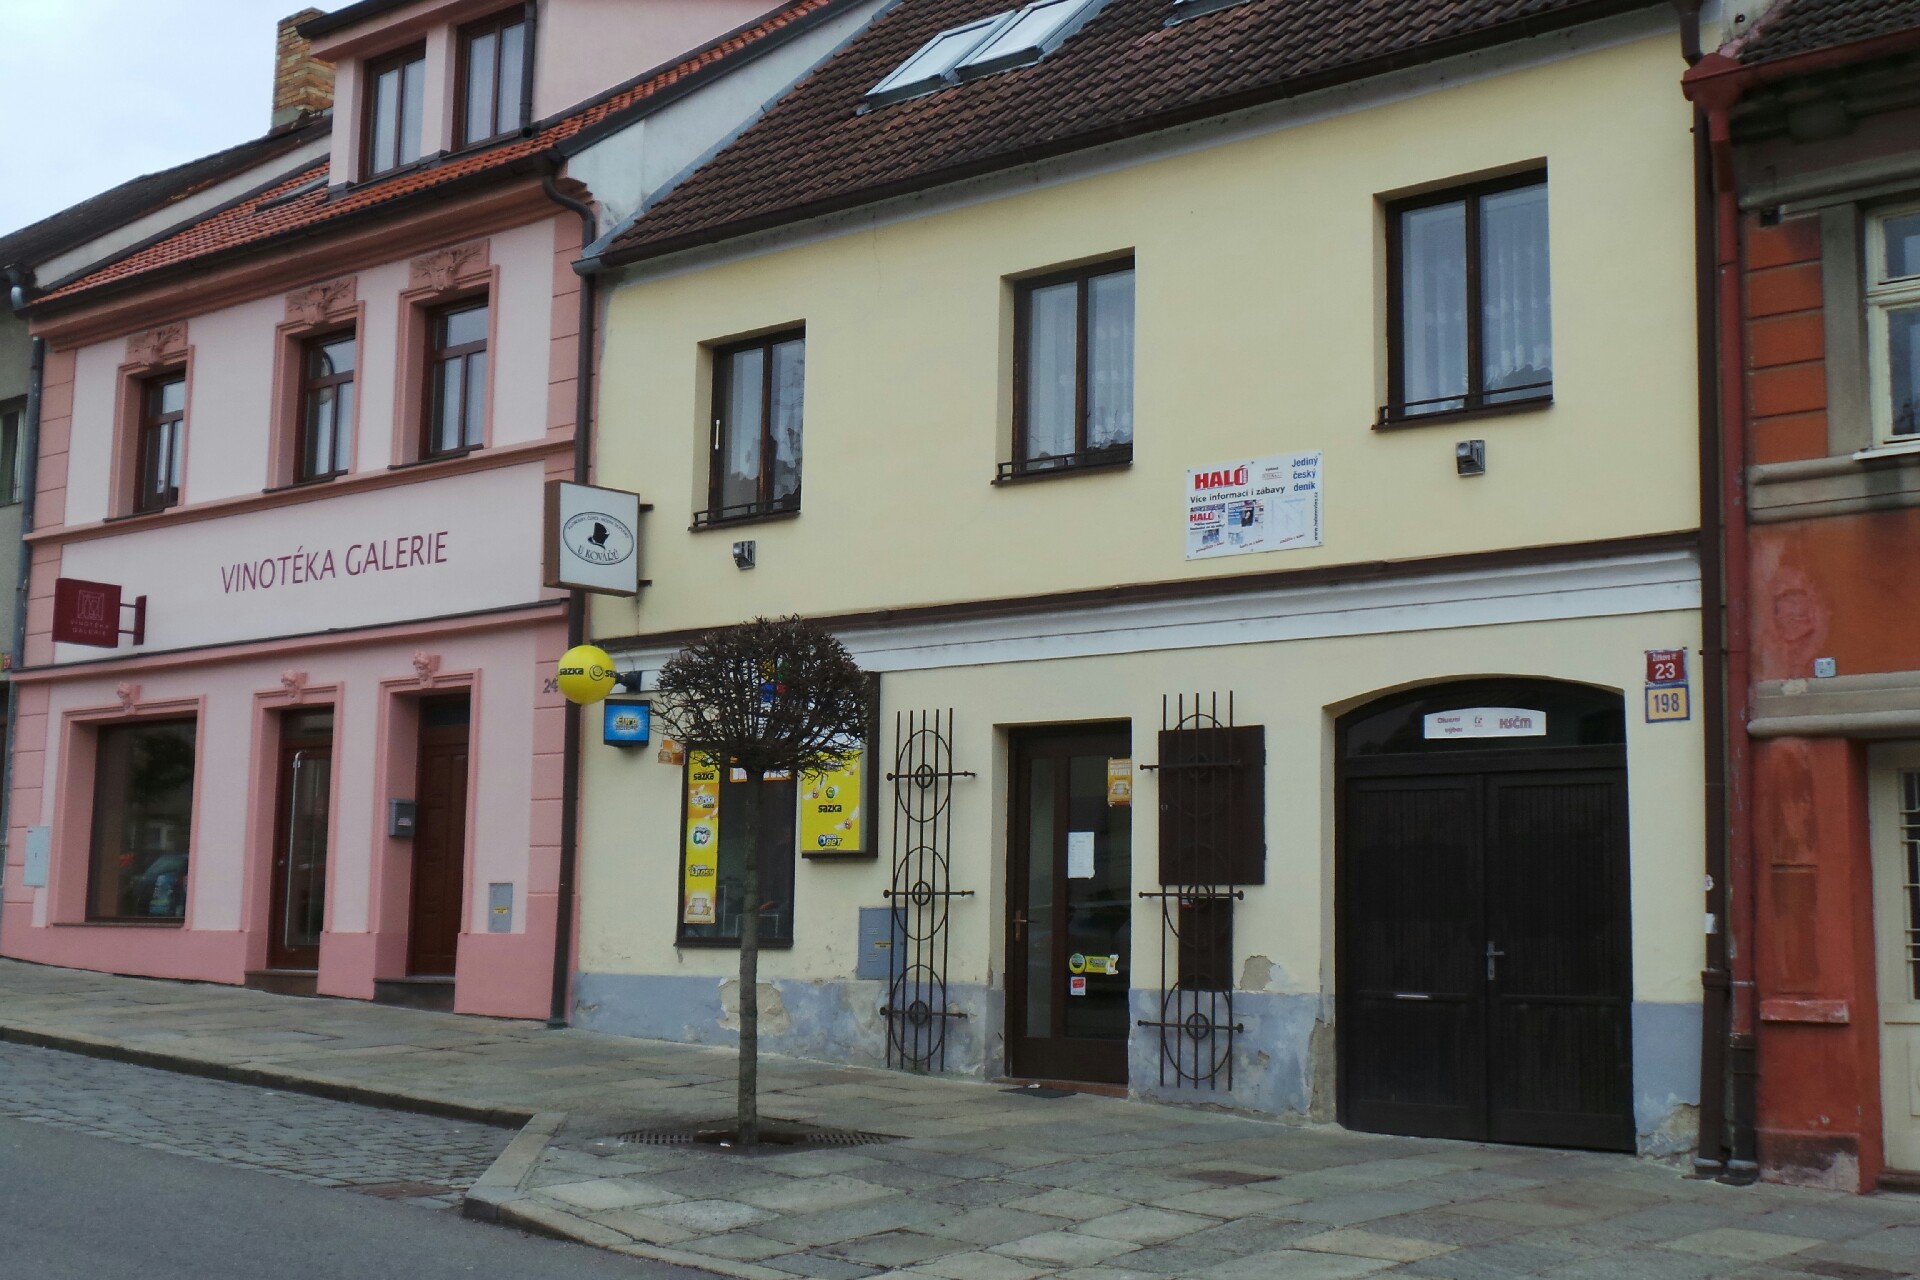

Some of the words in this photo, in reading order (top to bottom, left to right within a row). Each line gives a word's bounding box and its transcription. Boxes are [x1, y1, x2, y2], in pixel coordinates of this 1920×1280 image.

[1292, 456, 1318, 468] Jediný
[1194, 464, 1248, 490] HALÓ
[1293, 468, 1316, 479] český
[578, 544, 585, 555] U
[221, 545, 336, 594] VINOTÉKA
[345, 531, 448, 576] GALERIE
[1655, 662, 1676, 680] 23
[1654, 693, 1680, 714] 198
